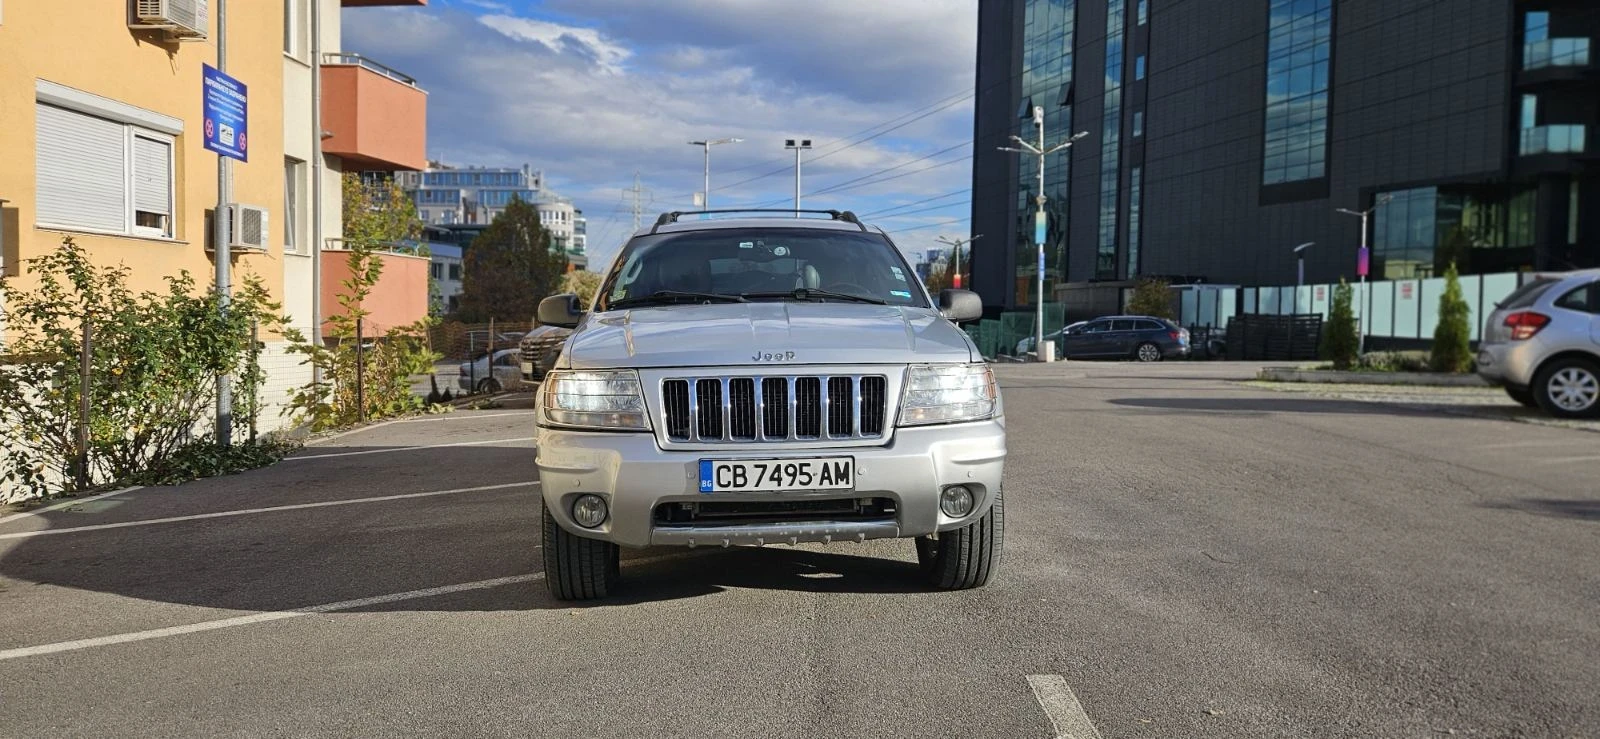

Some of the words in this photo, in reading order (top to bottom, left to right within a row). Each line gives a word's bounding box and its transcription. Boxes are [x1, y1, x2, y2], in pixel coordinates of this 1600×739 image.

[701, 479, 712, 488] BG
[716, 464, 748, 488] CB
[753, 463, 813, 487] 7495
[818, 461, 850, 486] AM
